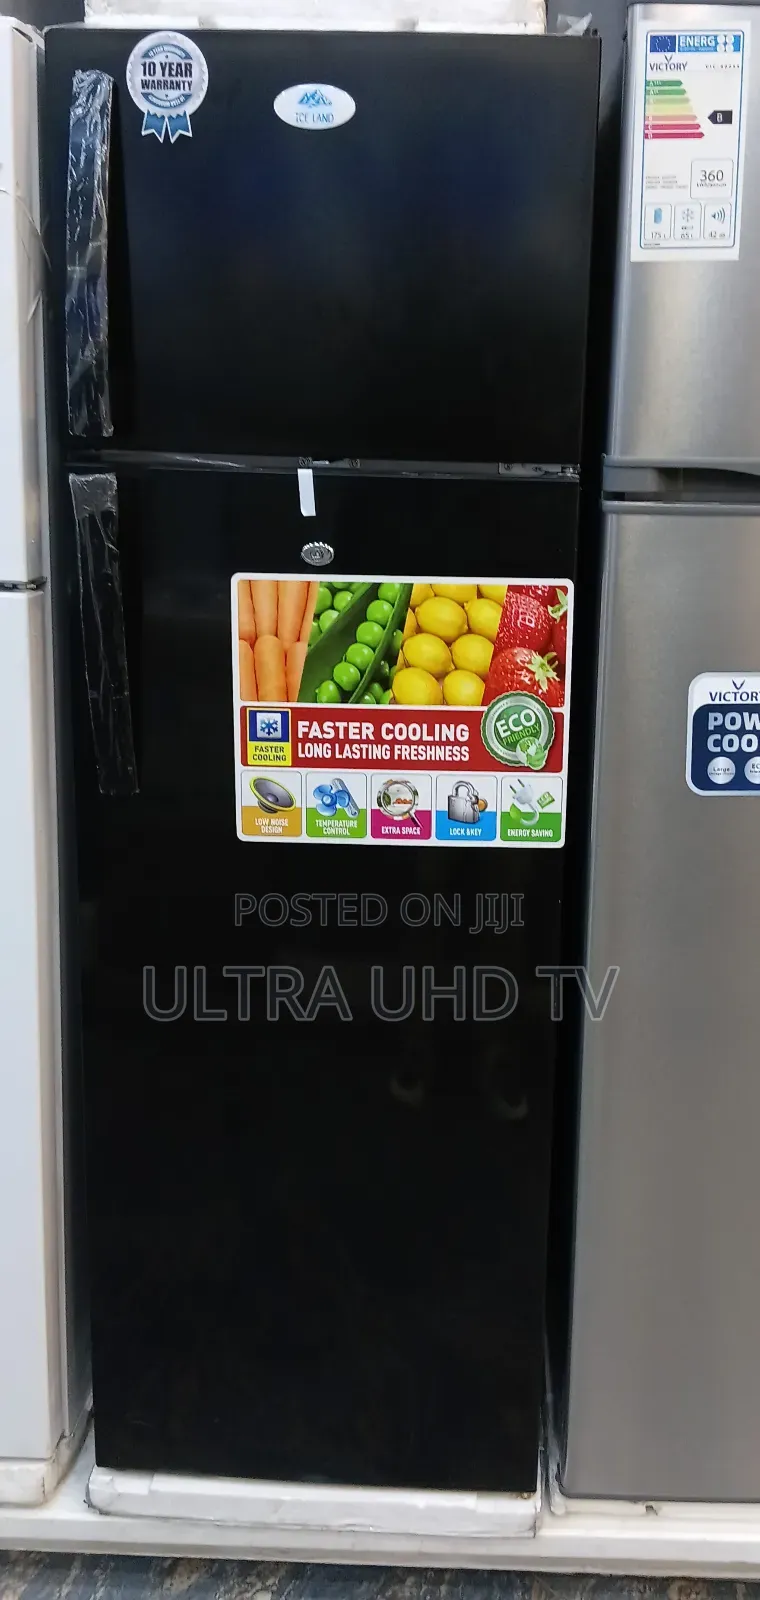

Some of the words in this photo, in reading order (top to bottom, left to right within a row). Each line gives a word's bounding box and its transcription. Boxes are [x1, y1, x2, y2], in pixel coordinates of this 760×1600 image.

[679, 35, 715, 47] ENERG
[141, 61, 156, 77] 10
[160, 61, 193, 78] YEAR
[649, 61, 688, 72] VICTORY
[141, 79, 193, 91] WARRANTY
[700, 169, 724, 181] 360
[495, 708, 536, 739] ECO
[297, 720, 375, 740] FASTER
[381, 723, 470, 742] COOLING
[502, 723, 541, 746] FRIENDLY
[706, 733, 759, 753] COO
[254, 744, 285, 754] FASTER
[297, 742, 332, 758] LONG
[335, 743, 391, 760] LASTING
[394, 745, 470, 762] FRESHNESS
[252, 753, 287, 762] COOLING
[255, 818, 269, 827] LOW
[270, 818, 289, 827] NOISE
[315, 819, 358, 828] TEMPERATURE
[261, 825, 283, 834] DESIGN
[323, 826, 351, 835] CONTROL
[381, 826, 400, 835] EXTRA
[401, 826, 421, 836] SPACE
[450, 827, 464, 836] LOCK
[507, 828, 530, 838] ENERGY
[531, 829, 554, 838] SAVING
